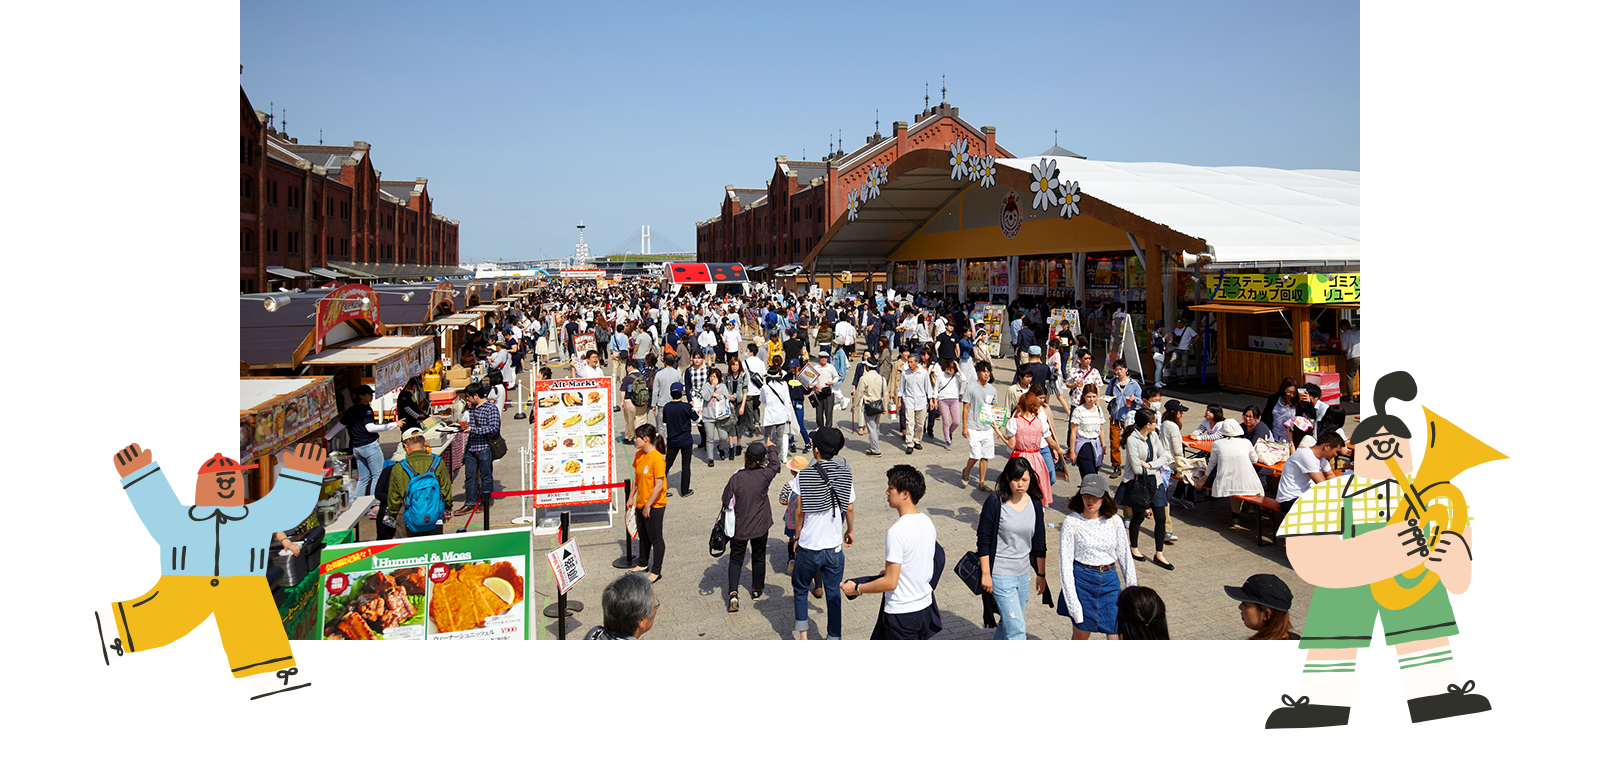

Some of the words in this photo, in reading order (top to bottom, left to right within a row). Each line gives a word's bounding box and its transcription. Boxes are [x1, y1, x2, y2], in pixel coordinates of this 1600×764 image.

[1213, 276, 1296, 288] ゴミステーション
[379, 554, 429, 568] Hummel
[430, 553, 441, 562] &
[442, 551, 472, 561] Moas
[564, 556, 579, 582] 順路
